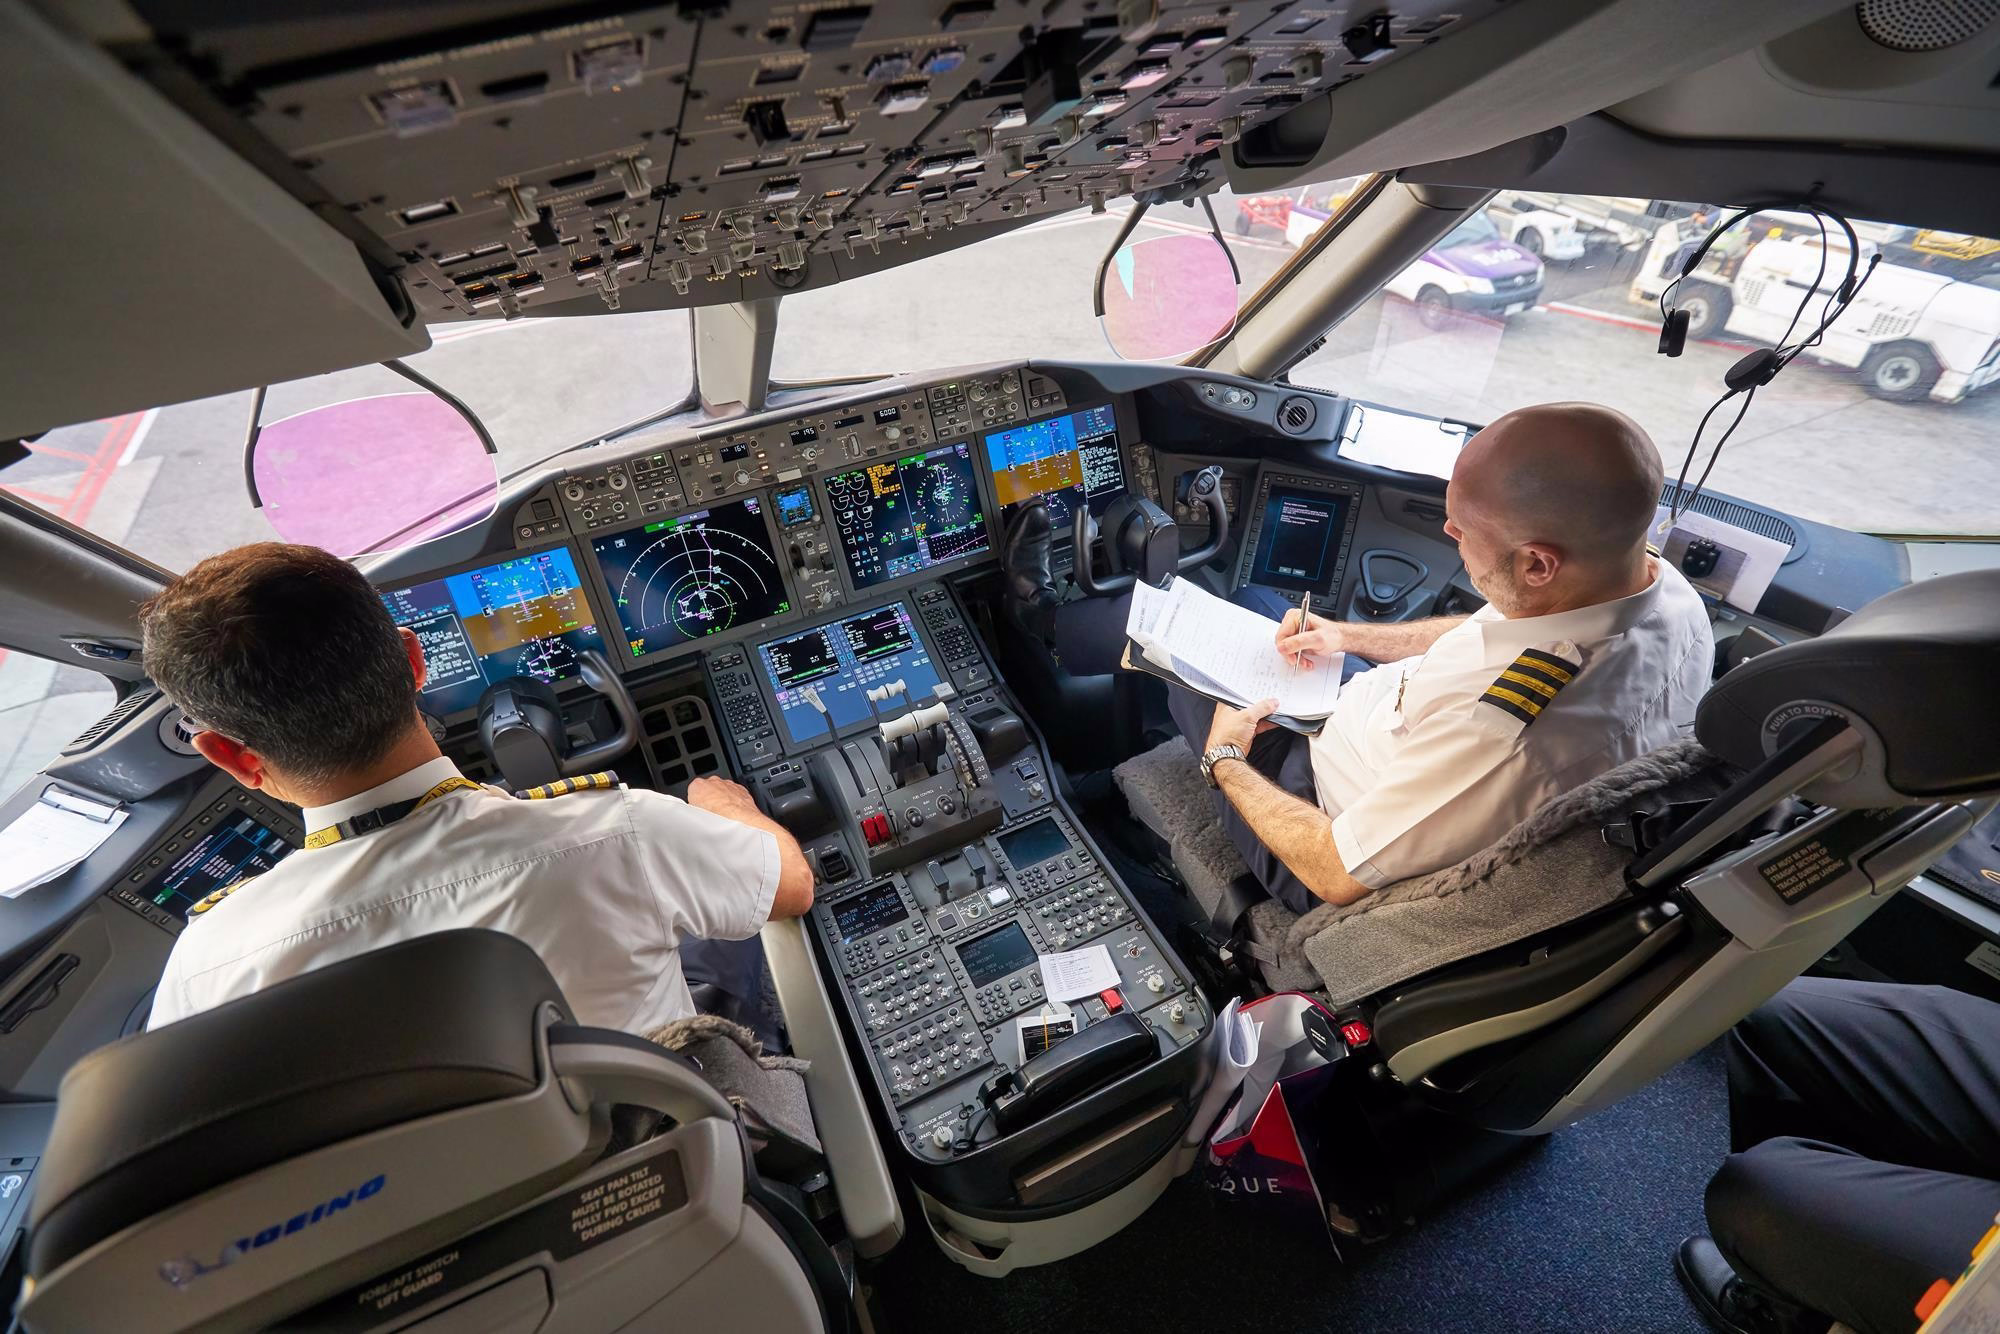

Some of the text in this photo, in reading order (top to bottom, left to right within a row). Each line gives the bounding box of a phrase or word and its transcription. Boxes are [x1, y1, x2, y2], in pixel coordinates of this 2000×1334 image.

[878, 407, 896, 417] 6000
[802, 427, 815, 436] 195
[1769, 711, 1788, 731] PUSH
[1787, 707, 1802, 717] TO
[919, 789, 934, 797] CONTROL
[925, 1118, 937, 1126] DOOR
[938, 1110, 952, 1119] ACCESS
[933, 1120, 943, 1129] AUTO
[571, 1174, 663, 1220] MUST BE ROTATED
[581, 1166, 649, 1203] SEAT PAN TILT
[572, 1184, 665, 1232] FULLY FWD EXCEPT
[580, 1198, 662, 1242] DURING CRUISE
[358, 1251, 459, 1304] FORE/AFT SWITCH
[376, 1271, 444, 1309] LIFT GUARD
